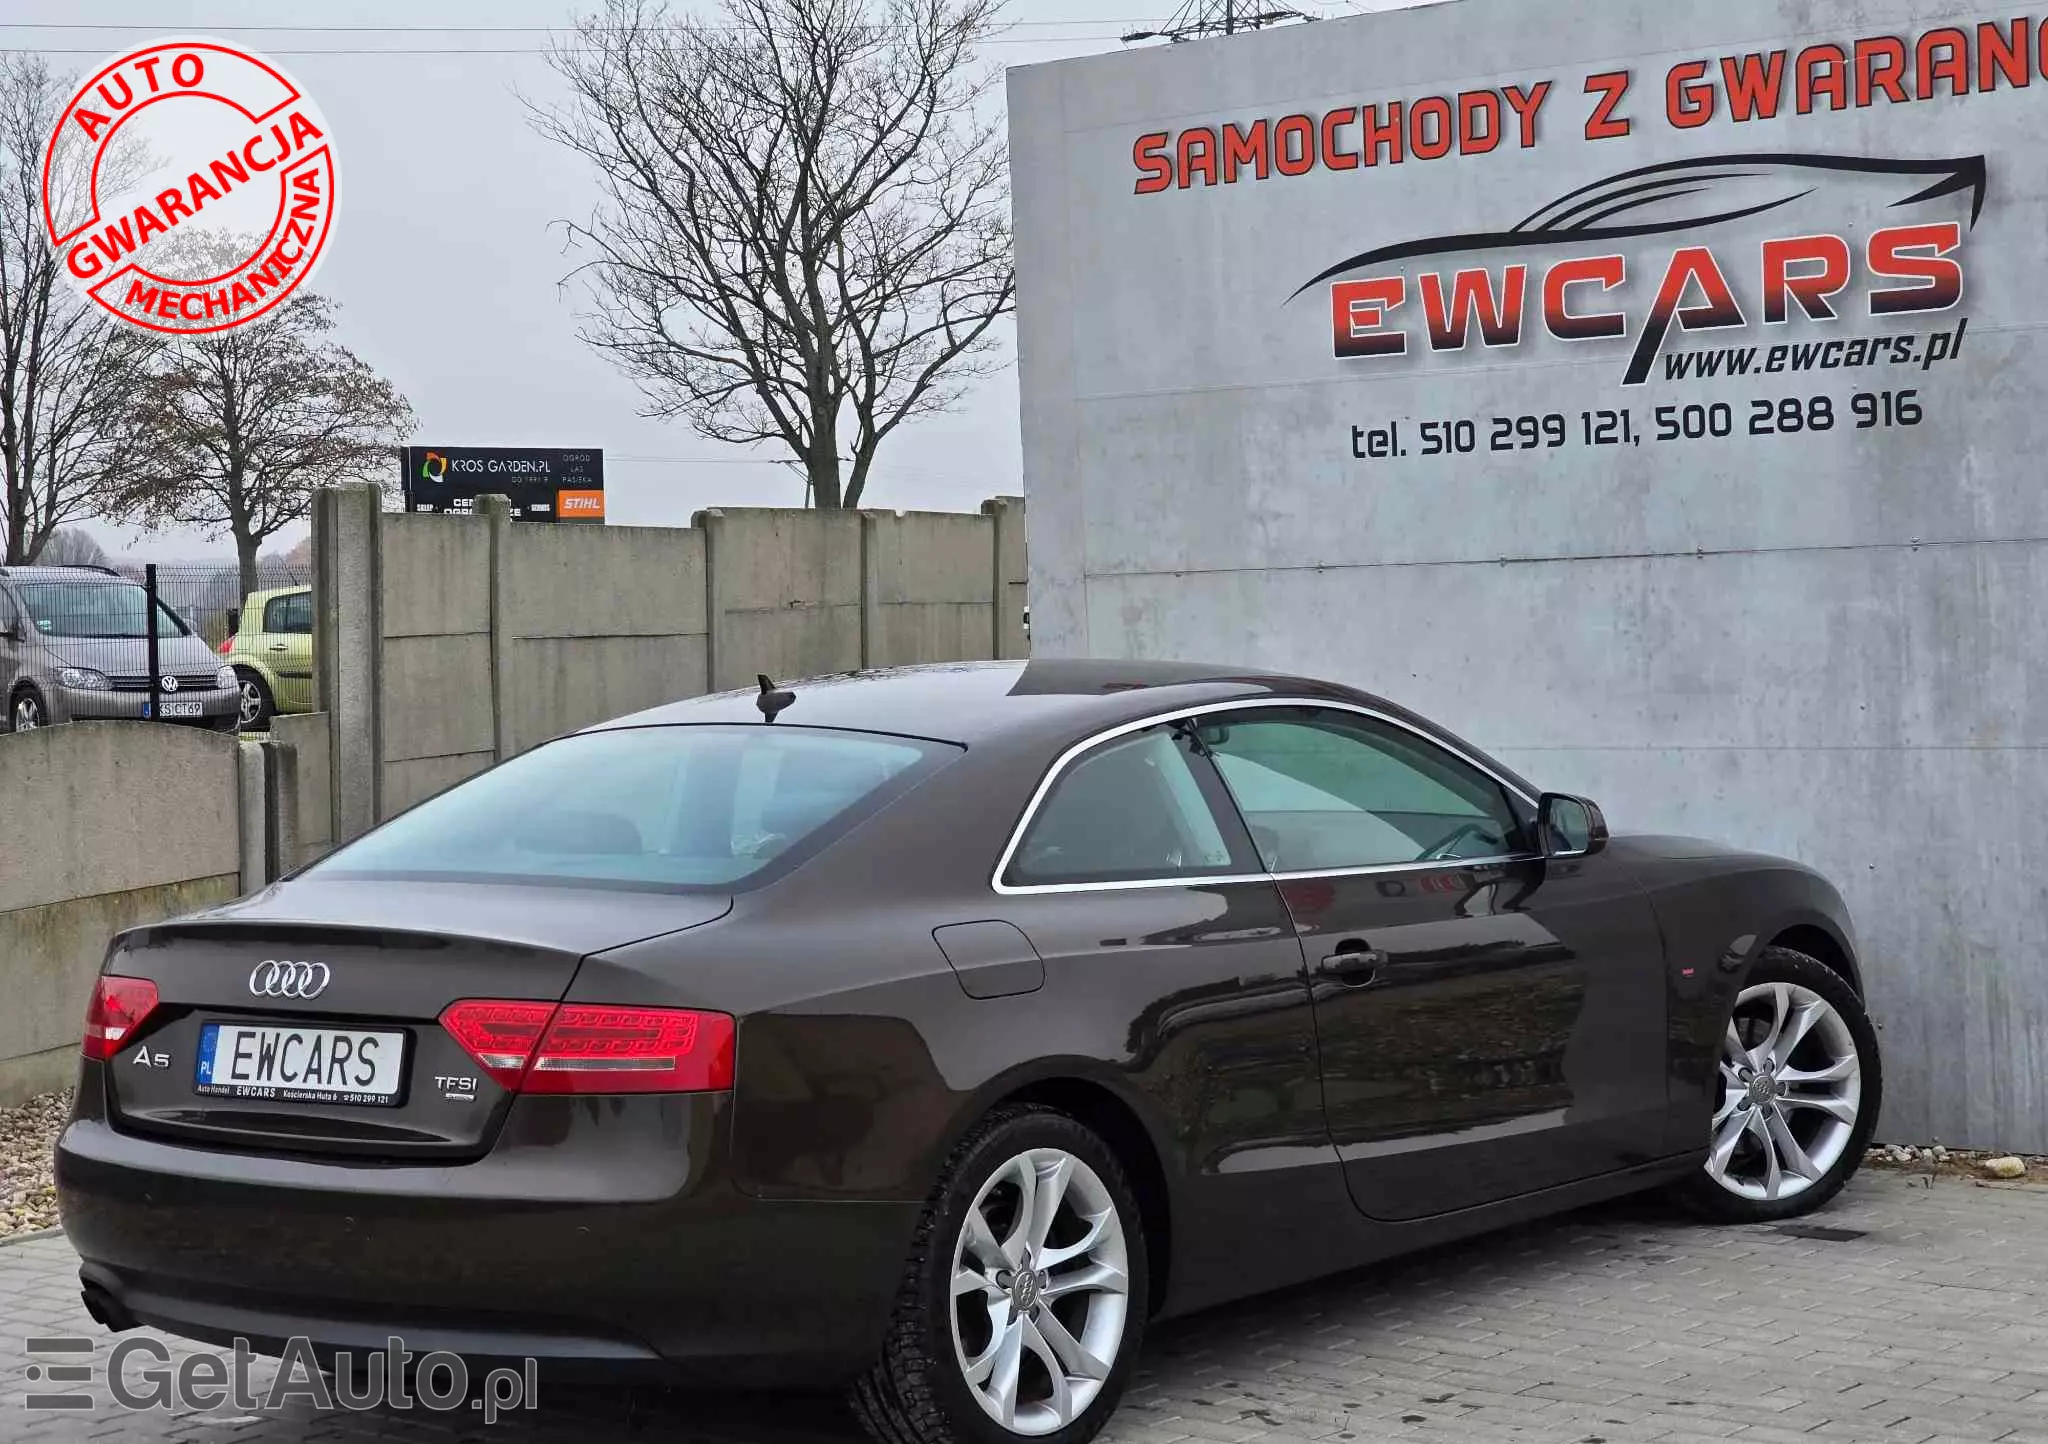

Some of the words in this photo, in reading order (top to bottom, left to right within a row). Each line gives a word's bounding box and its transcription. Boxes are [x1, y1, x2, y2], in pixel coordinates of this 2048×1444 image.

[1133, 80, 1552, 194] SAMOCHODY
[1584, 70, 1630, 140] Z
[1665, 14, 2048, 129] GWARAN
[1332, 222, 1964, 386] EWCARS
[1665, 318, 1969, 381] www.ewcars.pl
[1351, 421, 1407, 459] tel.
[1420, 420, 1476, 455] 510
[1490, 413, 1566, 451] 299
[1582, 408, 1640, 447] 121,
[1655, 403, 1732, 441] 500
[1748, 396, 1835, 434] 288
[1850, 389, 1923, 429] 916
[451, 459, 484, 472] KROS
[487, 459, 550, 473] GARDEN.PL
[563, 497, 601, 509] STIHL
[133, 1045, 170, 1069] A5
[201, 1061, 211, 1075] PL
[231, 1031, 380, 1087] EWCARS
[236, 1086, 276, 1098] EWCARS
[434, 1076, 477, 1091] TFSI
